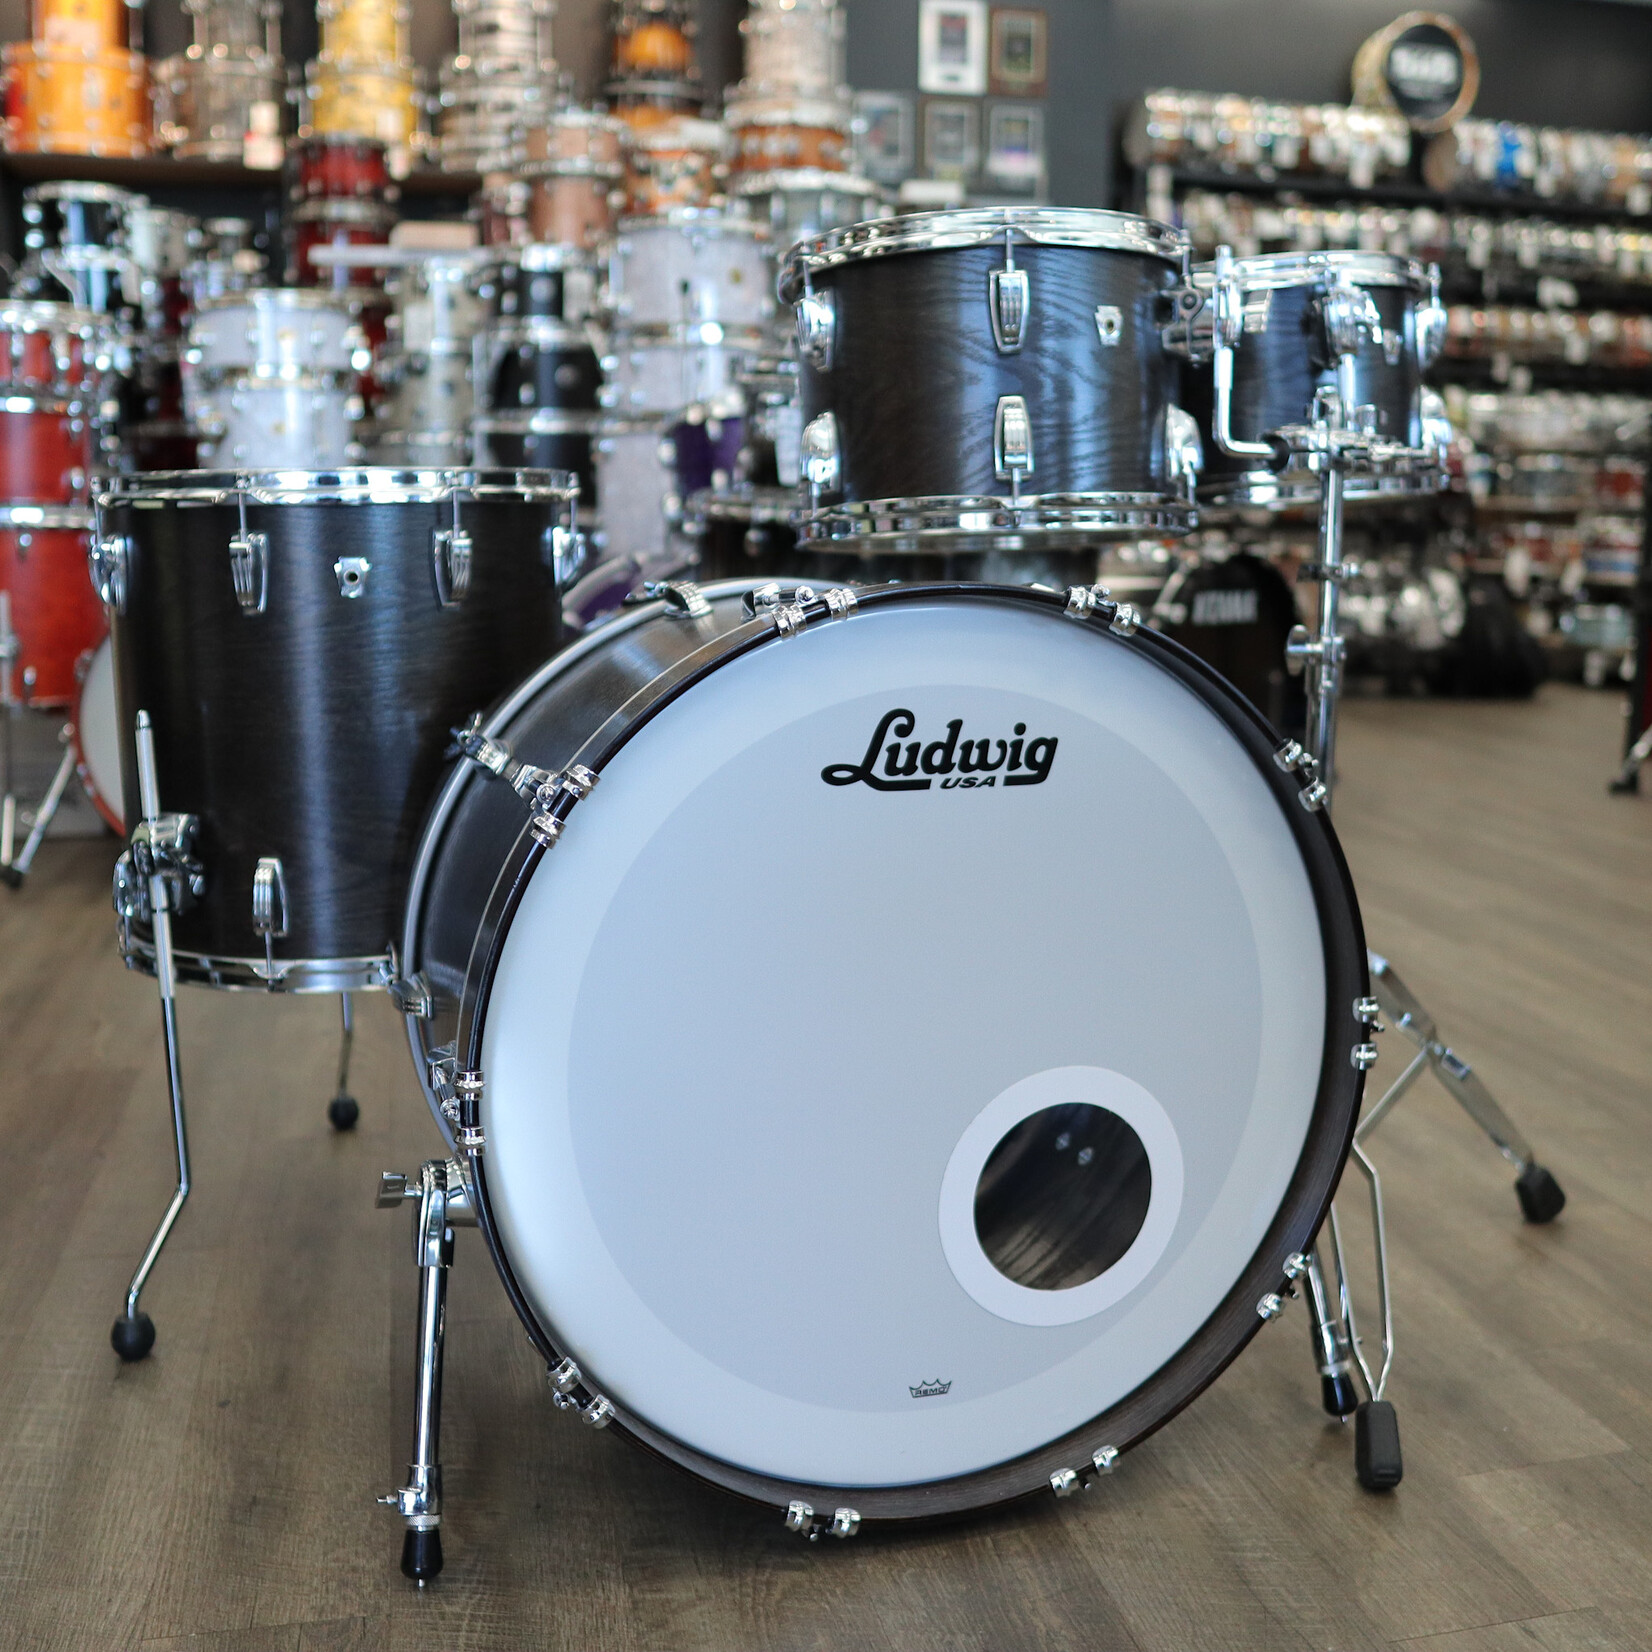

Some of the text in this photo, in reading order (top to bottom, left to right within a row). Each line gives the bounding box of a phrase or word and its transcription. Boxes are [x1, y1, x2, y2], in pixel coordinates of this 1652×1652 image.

[821, 708, 1058, 791] Ludwig
[940, 776, 996, 789] USA
[913, 1385, 948, 1397] REMO
